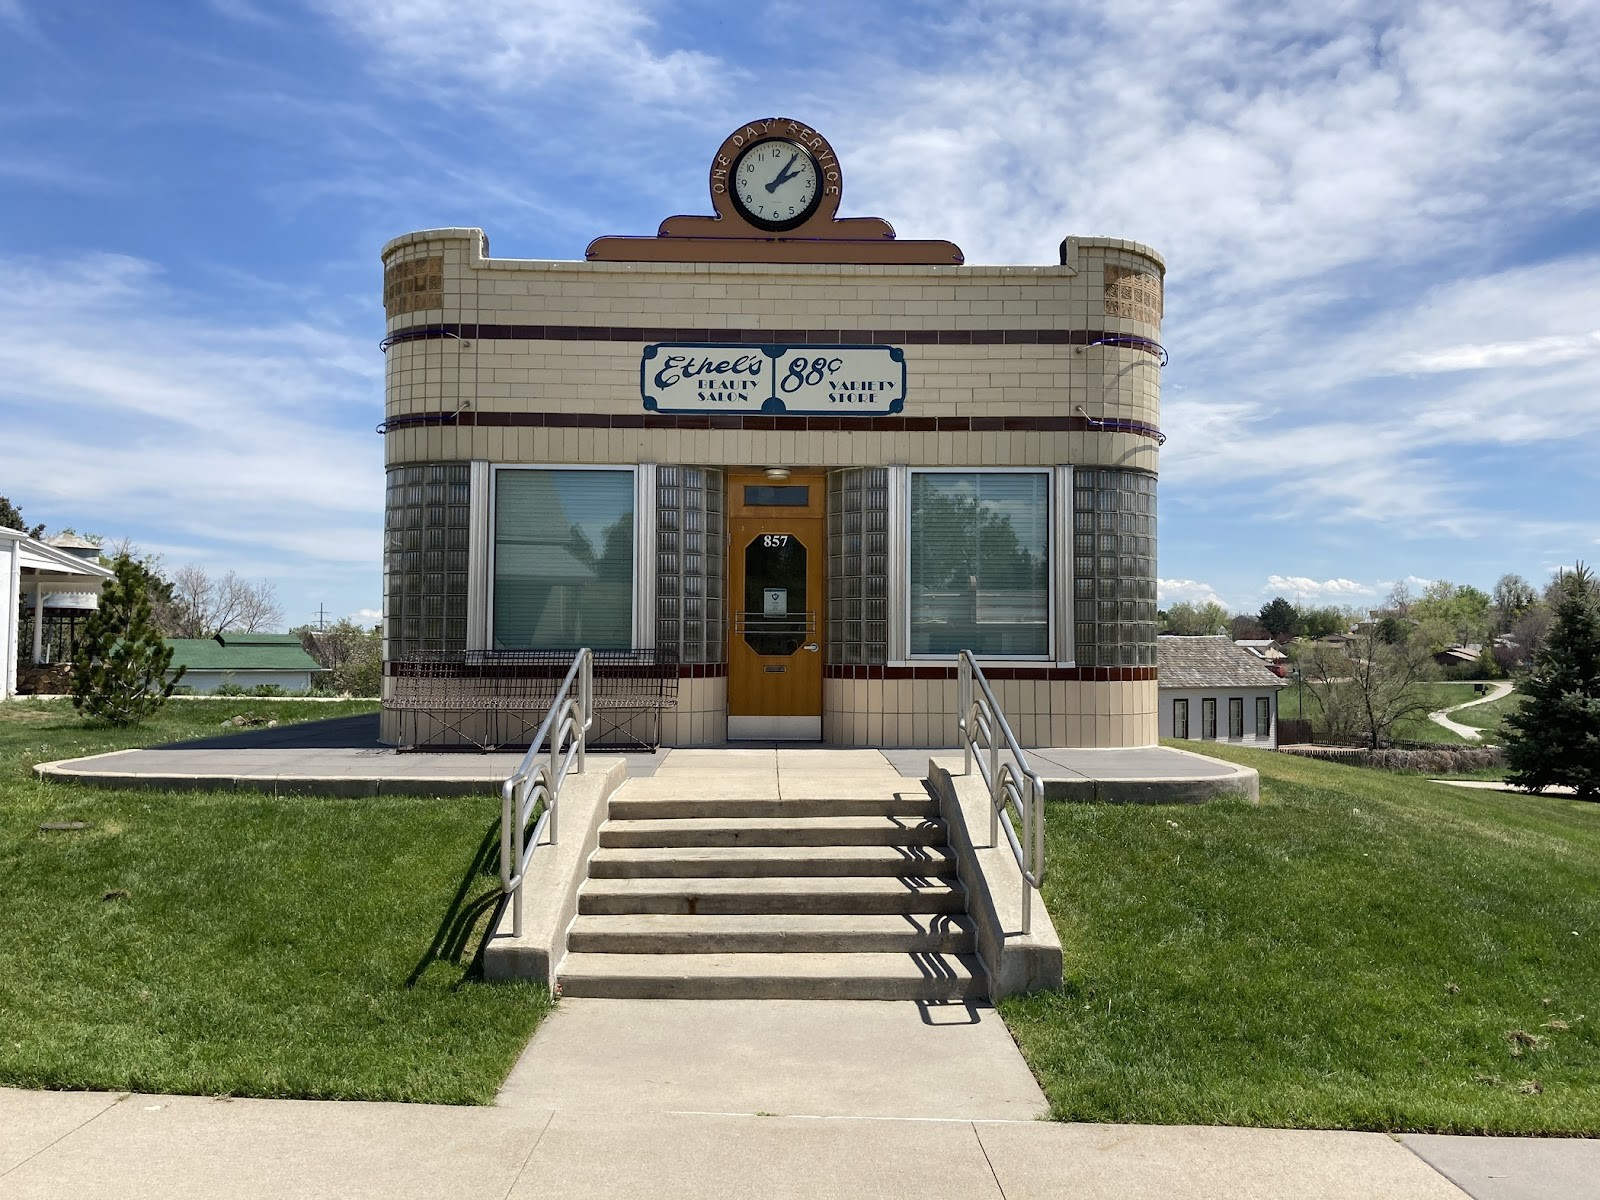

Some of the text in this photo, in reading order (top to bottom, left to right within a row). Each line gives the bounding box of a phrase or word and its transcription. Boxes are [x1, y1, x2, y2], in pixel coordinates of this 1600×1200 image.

[758, 153, 765, 162] 11
[772, 148, 781, 158] 12
[713, 121, 839, 196] ONE DAY SERVICE
[746, 164, 755, 173] 10
[800, 163, 807, 173] 2
[741, 179, 748, 188] 9
[805, 179, 812, 188] 3
[746, 194, 753, 204] 8
[799, 195, 806, 204] 4
[758, 206, 764, 215] 7
[773, 210, 780, 219] 6
[788, 206, 795, 215] 5
[654, 355, 762, 391] Ethel's
[698, 379, 760, 390] BEAUTY
[828, 380, 897, 392] VARIETY
[697, 391, 749, 403] SALON
[828, 393, 879, 404] STORE
[763, 535, 788, 547] 857
